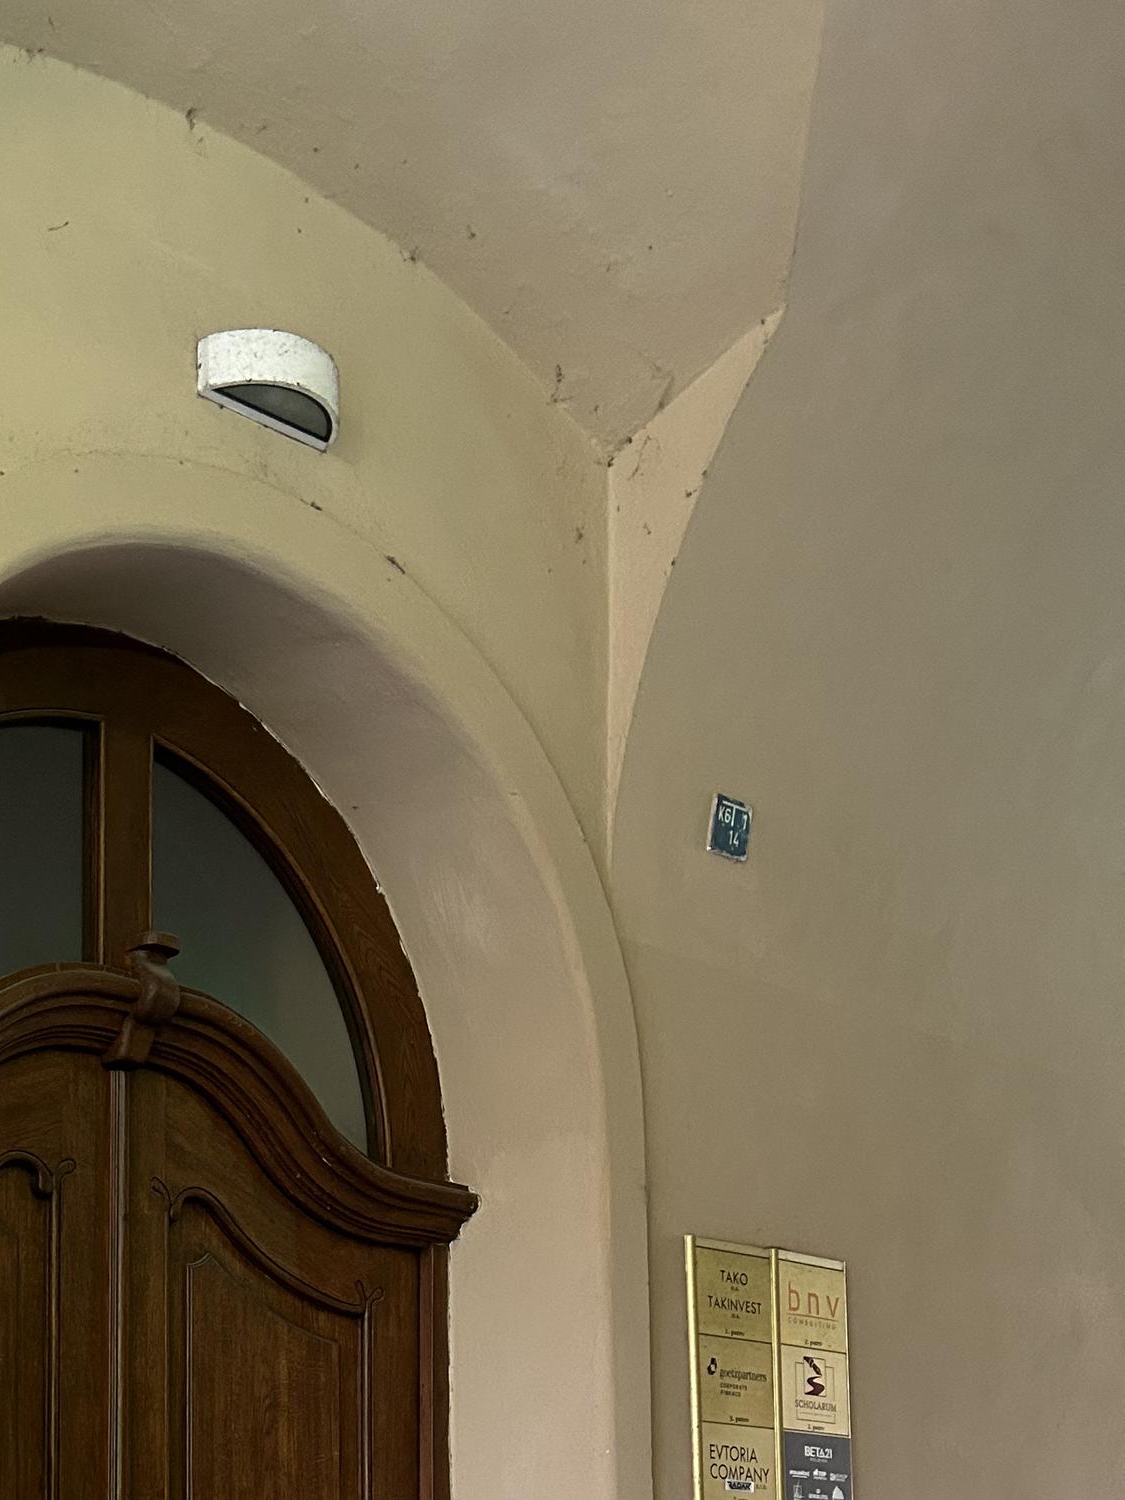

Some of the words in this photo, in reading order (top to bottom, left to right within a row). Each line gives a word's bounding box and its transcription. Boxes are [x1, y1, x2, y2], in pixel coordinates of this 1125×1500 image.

[720, 1269, 748, 1286] TAKO
[707, 1295, 762, 1315] TAKINVEST
[795, 1399, 836, 1412] SCHOLARUM
[709, 1444, 758, 1463] EVTORIA
[710, 1463, 769, 1484] COMPANY
